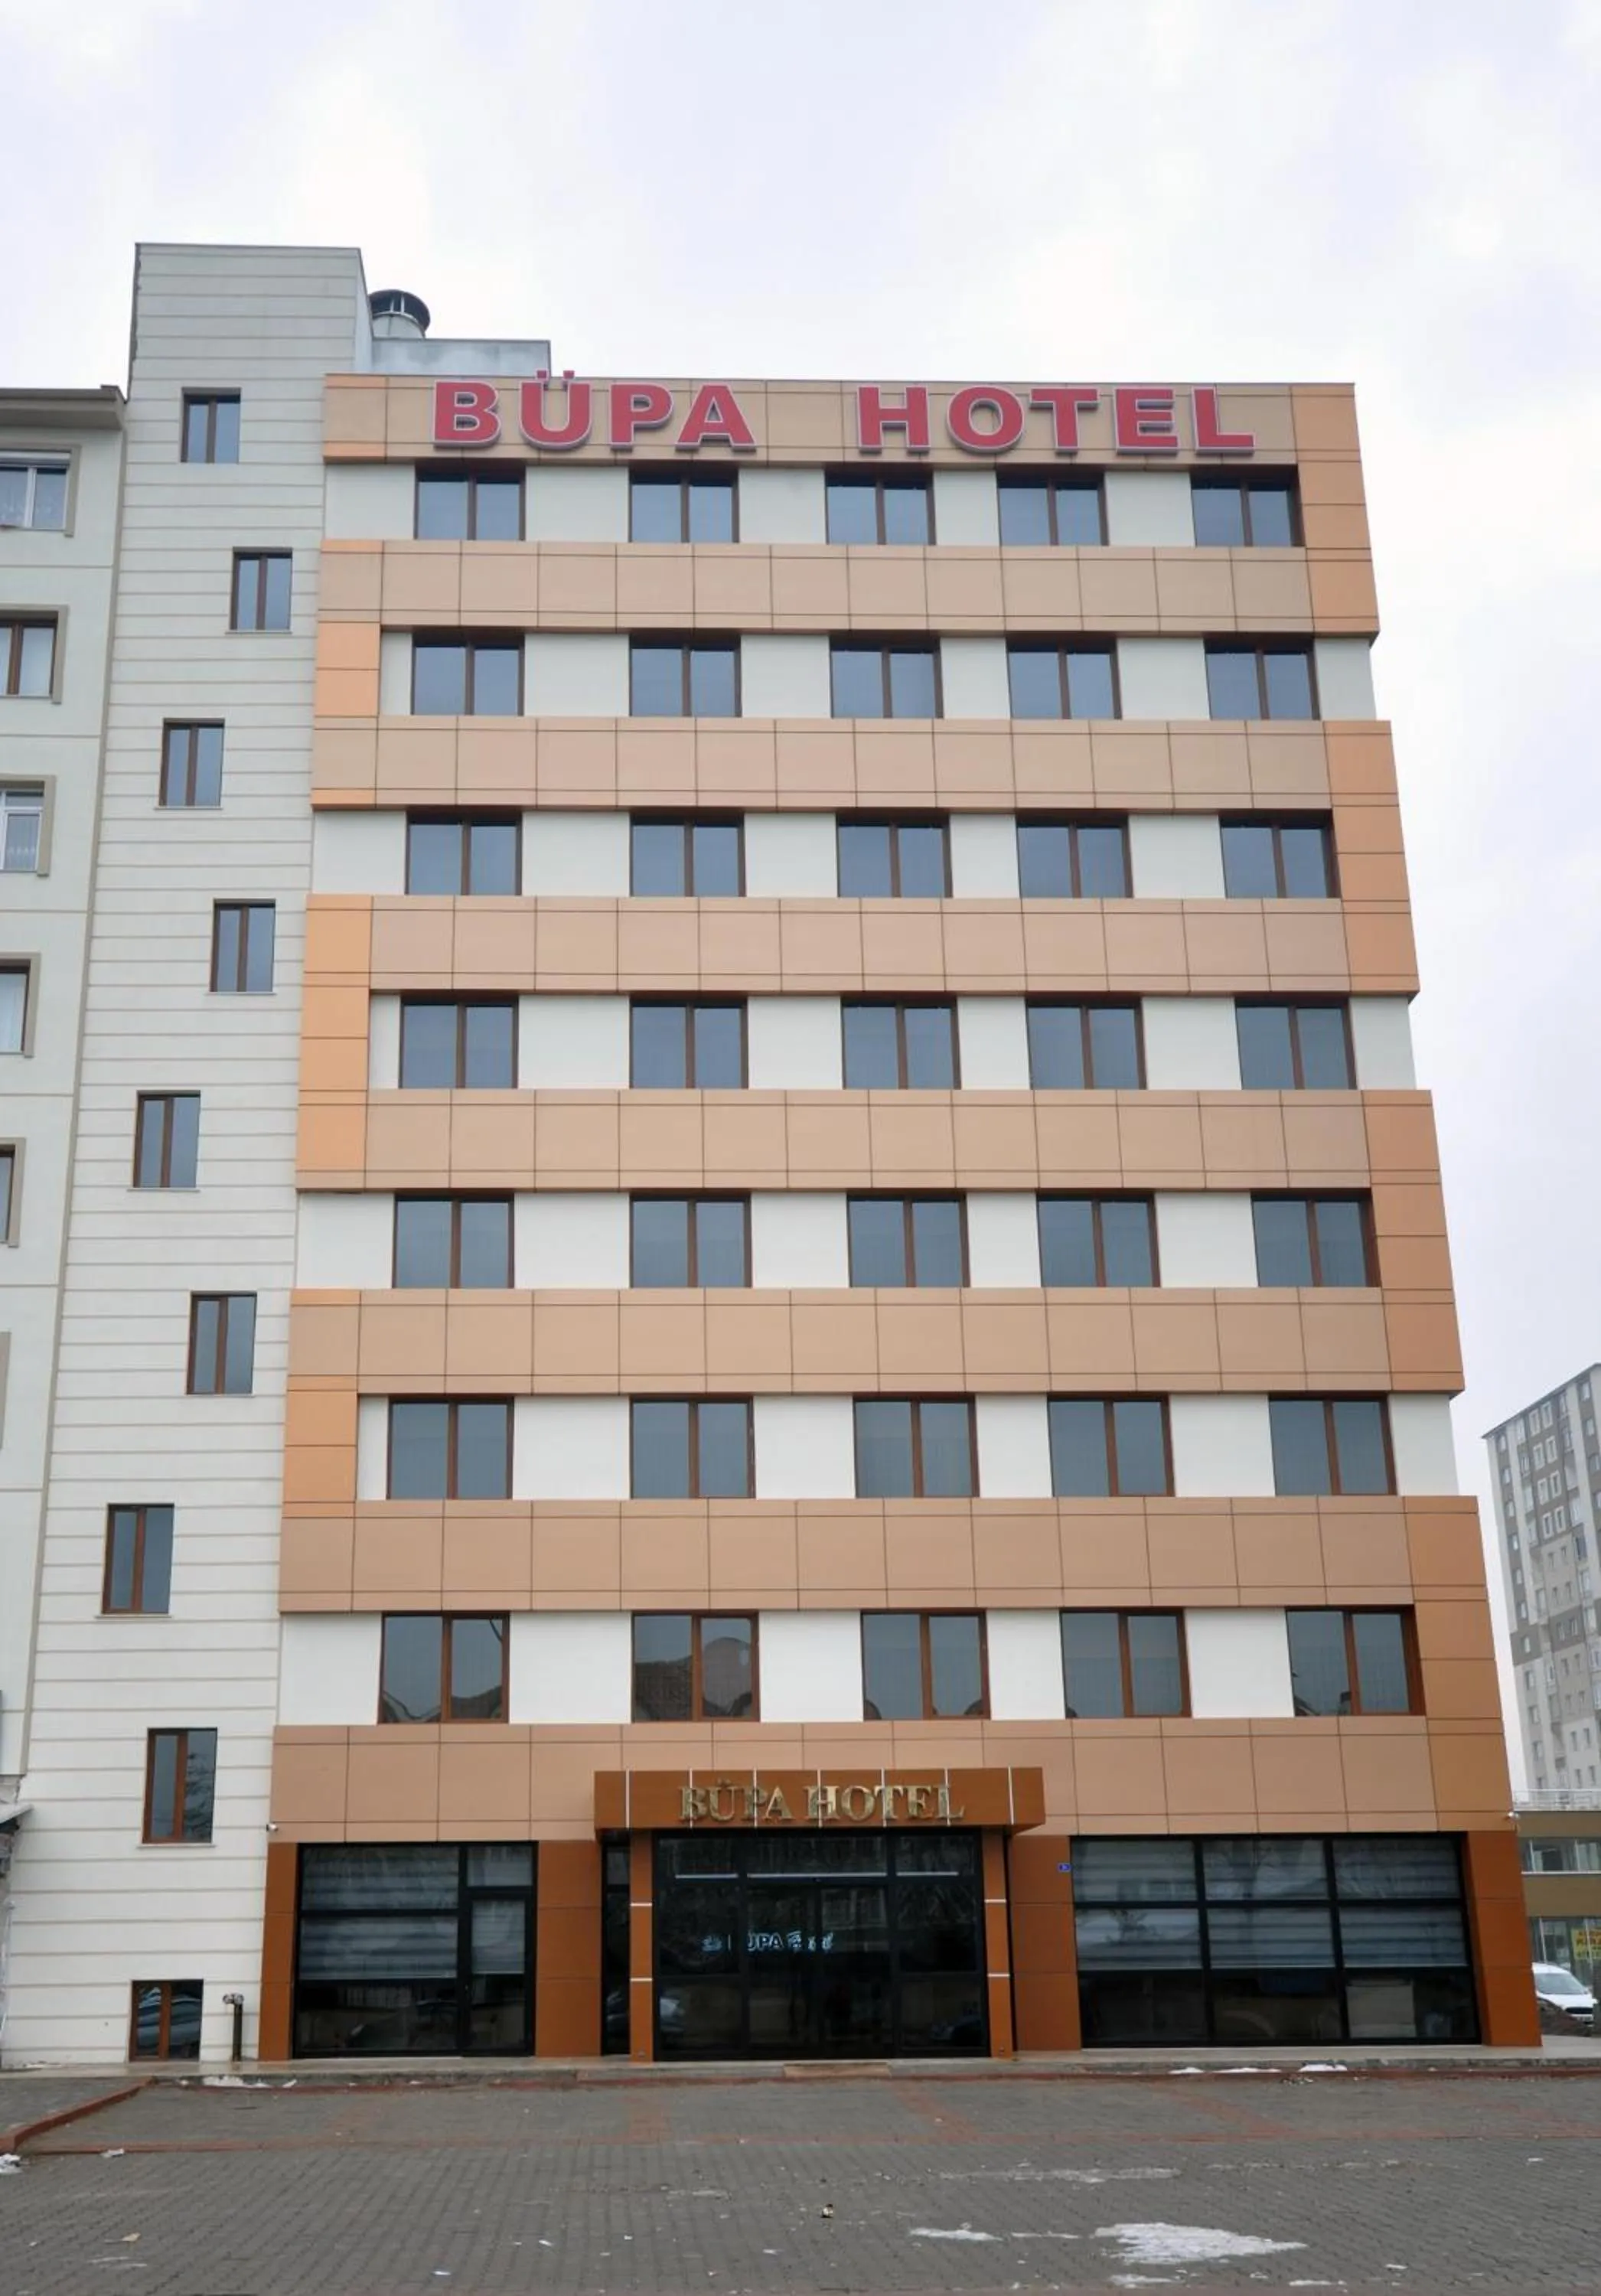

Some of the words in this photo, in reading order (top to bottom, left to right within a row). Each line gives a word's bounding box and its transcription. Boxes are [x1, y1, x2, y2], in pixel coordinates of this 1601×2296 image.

[434, 370, 757, 453] BÜPA
[857, 385, 1255, 455] HOTEL
[679, 1779, 795, 1821] BÜPA
[803, 1784, 965, 1821] HOTEL
